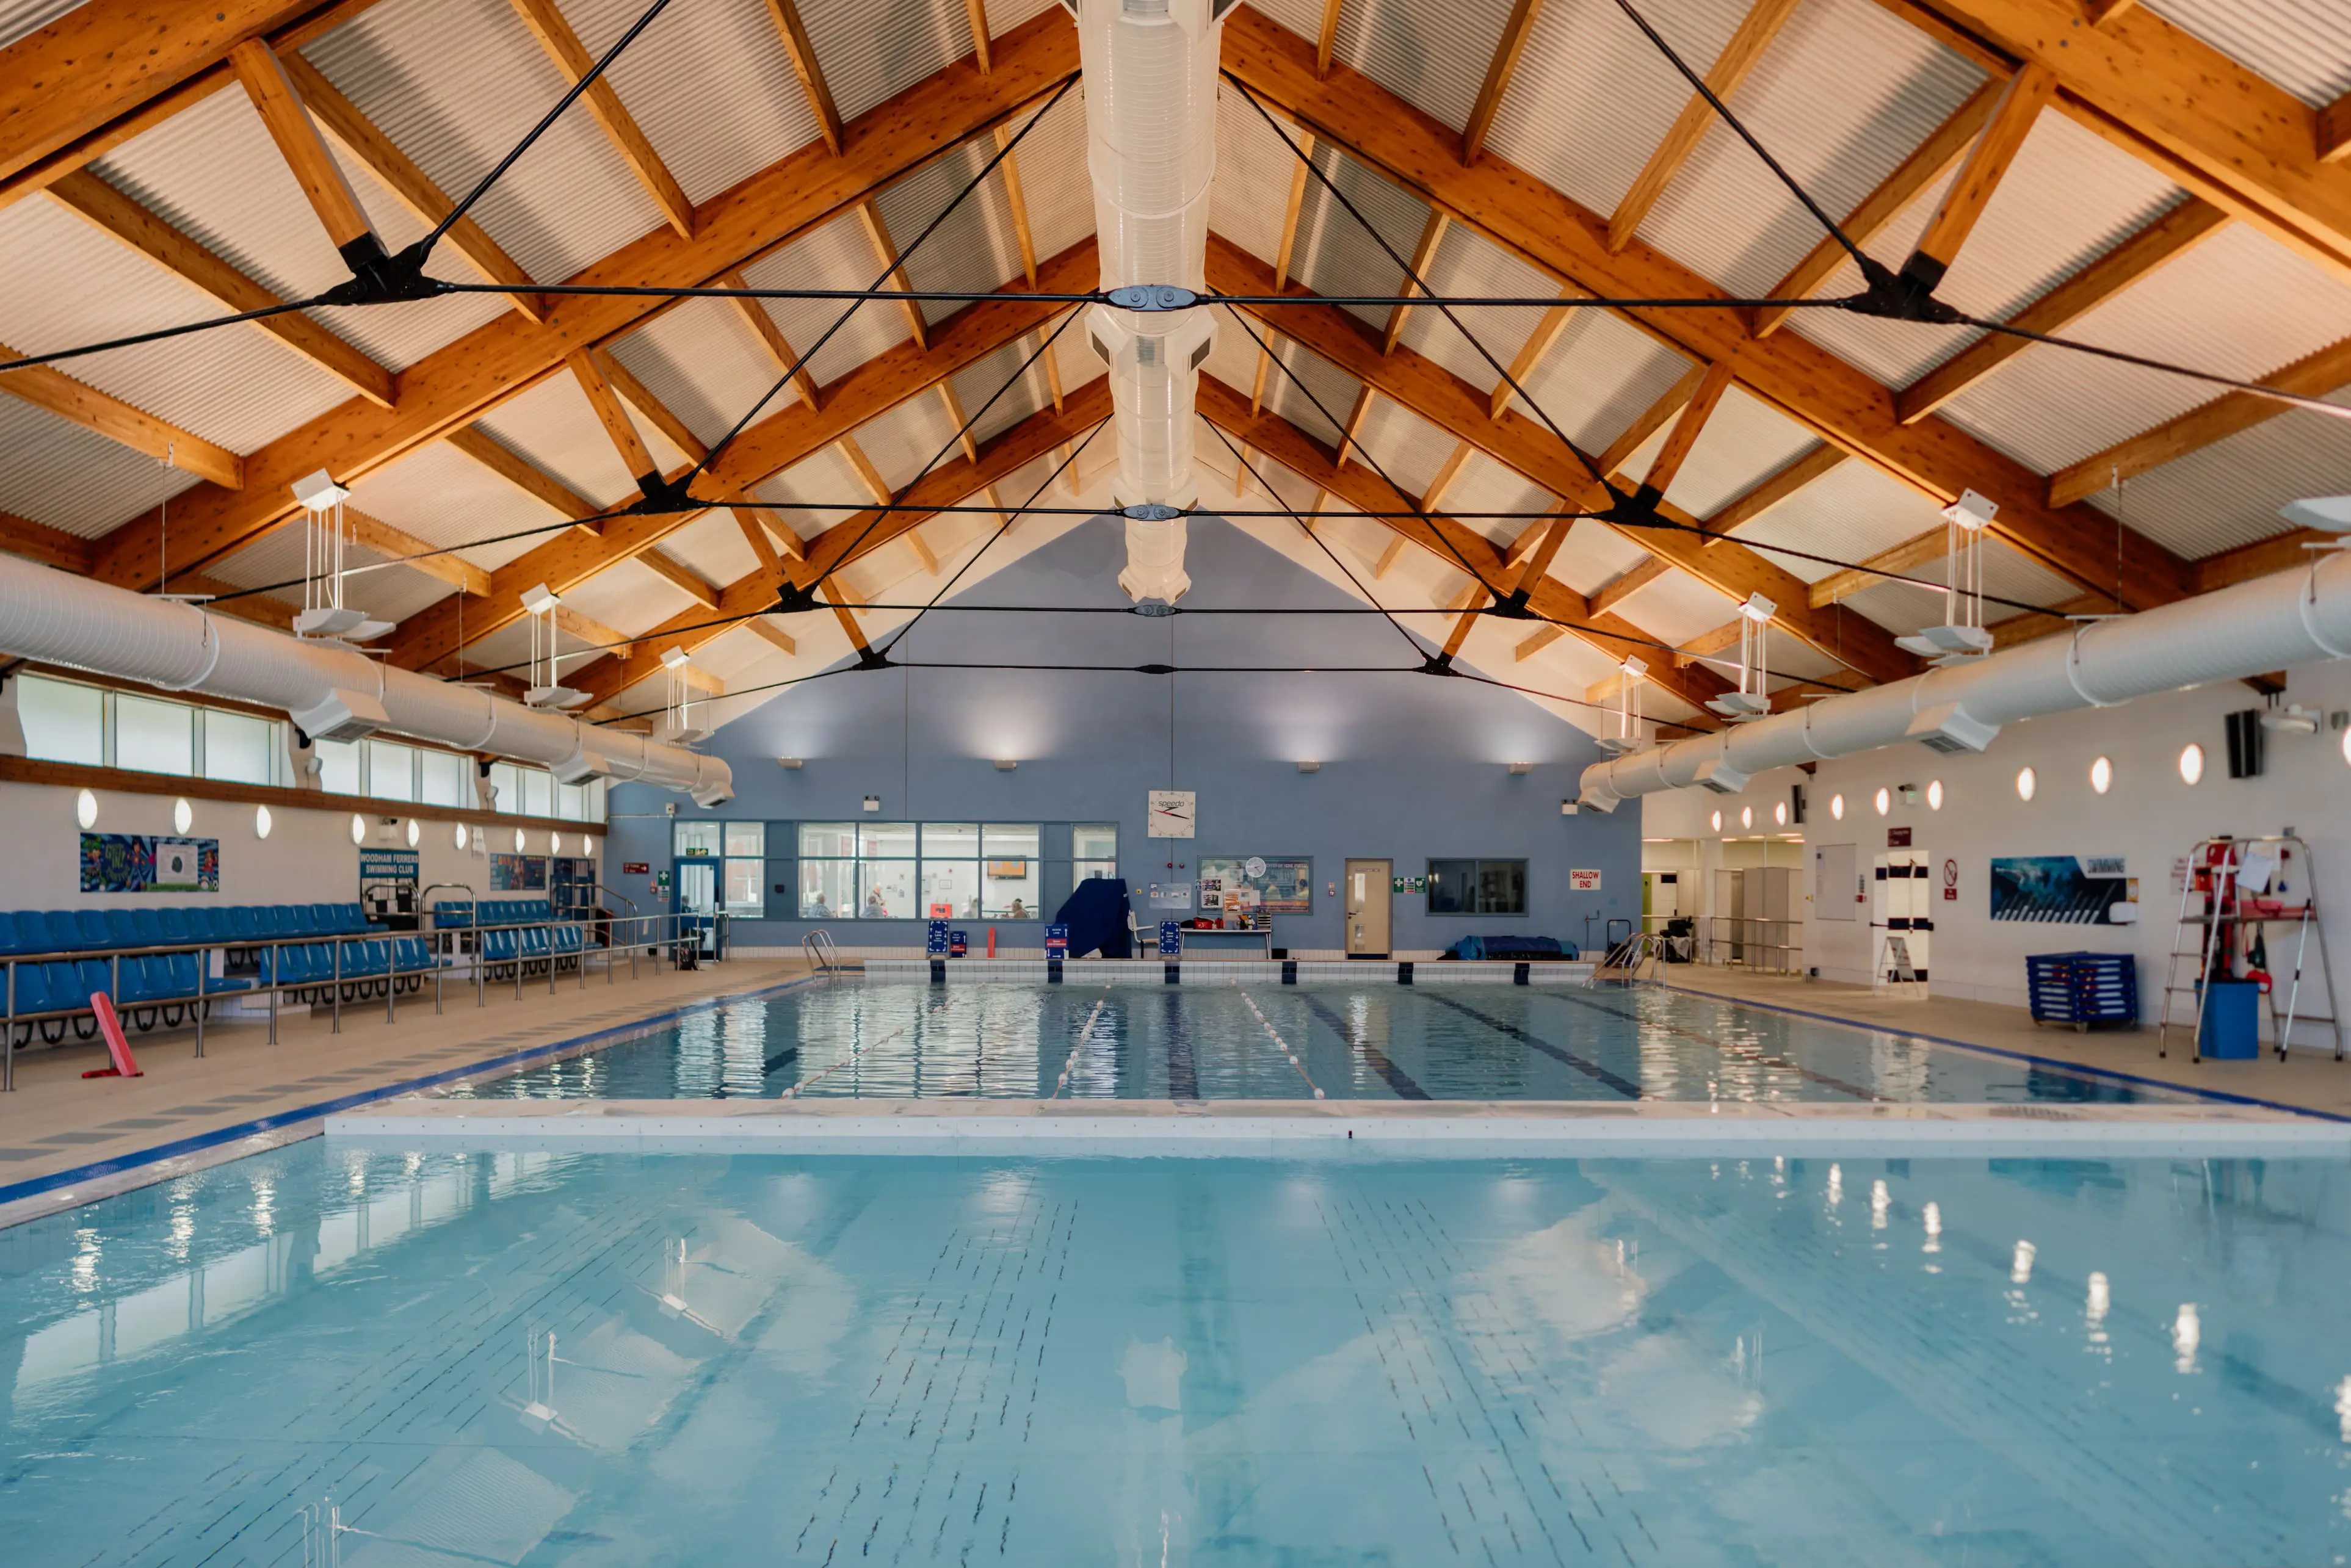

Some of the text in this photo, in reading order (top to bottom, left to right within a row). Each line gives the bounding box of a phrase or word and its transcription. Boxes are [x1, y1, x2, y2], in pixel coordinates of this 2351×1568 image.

[361, 853, 418, 864] WOODHAM FERRERS
[366, 864, 413, 874] SWIMMING CLUB
[2087, 858, 2125, 874] SWIMMING
